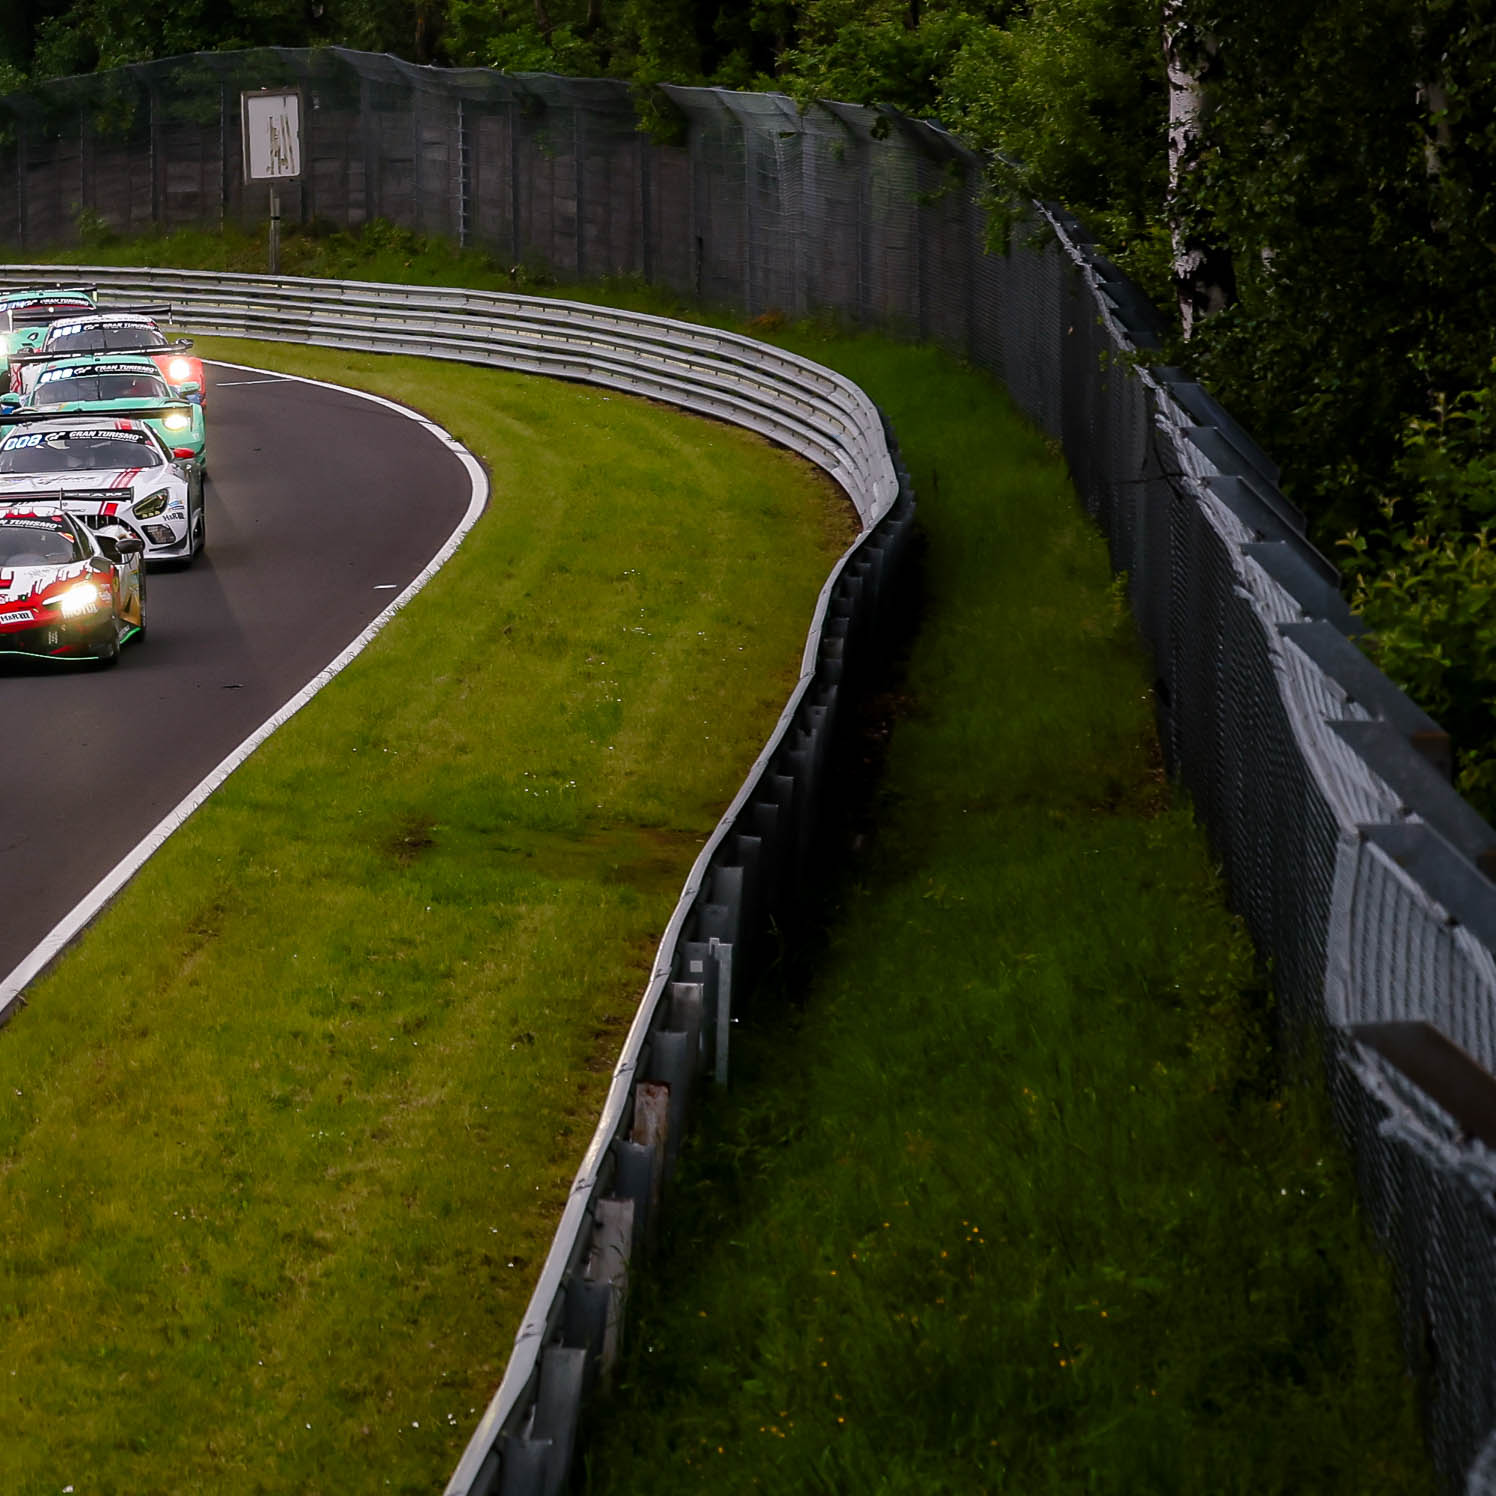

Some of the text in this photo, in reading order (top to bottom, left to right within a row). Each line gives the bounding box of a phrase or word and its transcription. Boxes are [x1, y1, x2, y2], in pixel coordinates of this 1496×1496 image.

[70, 430, 96, 438] GRAN
[98, 430, 141, 440] TURISMO
[5, 435, 42, 450] 008
[8, 519, 58, 529] TURISMO
